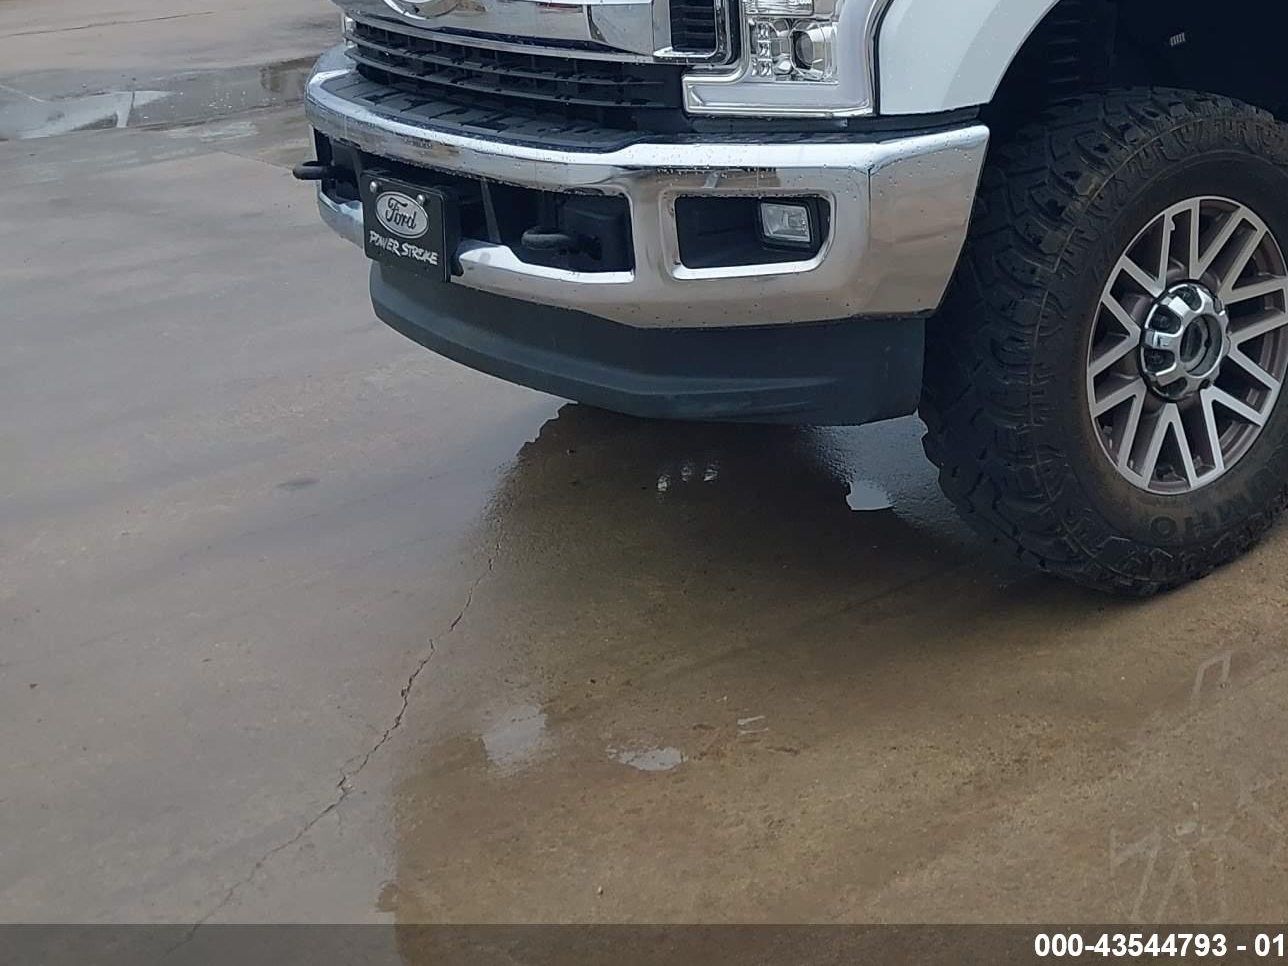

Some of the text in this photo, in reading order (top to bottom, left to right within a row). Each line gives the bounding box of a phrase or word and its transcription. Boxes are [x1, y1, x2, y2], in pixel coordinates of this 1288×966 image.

[385, 196, 418, 230] Ford
[369, 230, 439, 266] POWER STROKE
